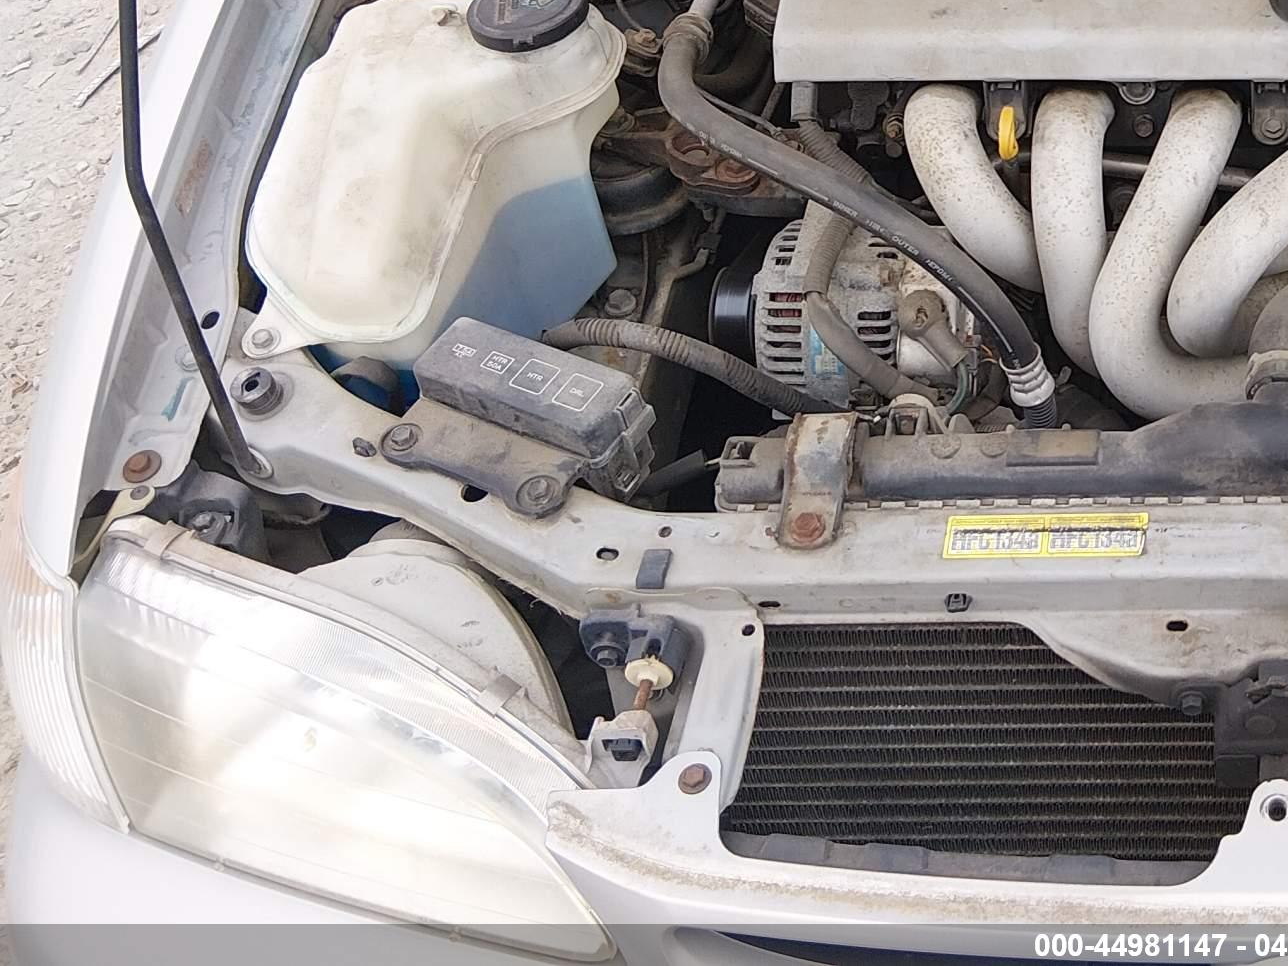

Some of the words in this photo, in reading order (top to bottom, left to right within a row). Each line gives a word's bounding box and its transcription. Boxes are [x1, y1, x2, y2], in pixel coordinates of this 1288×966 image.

[891, 235, 919, 256] OUTER
[492, 355, 508, 364] HTR
[527, 372, 544, 381] HTR
